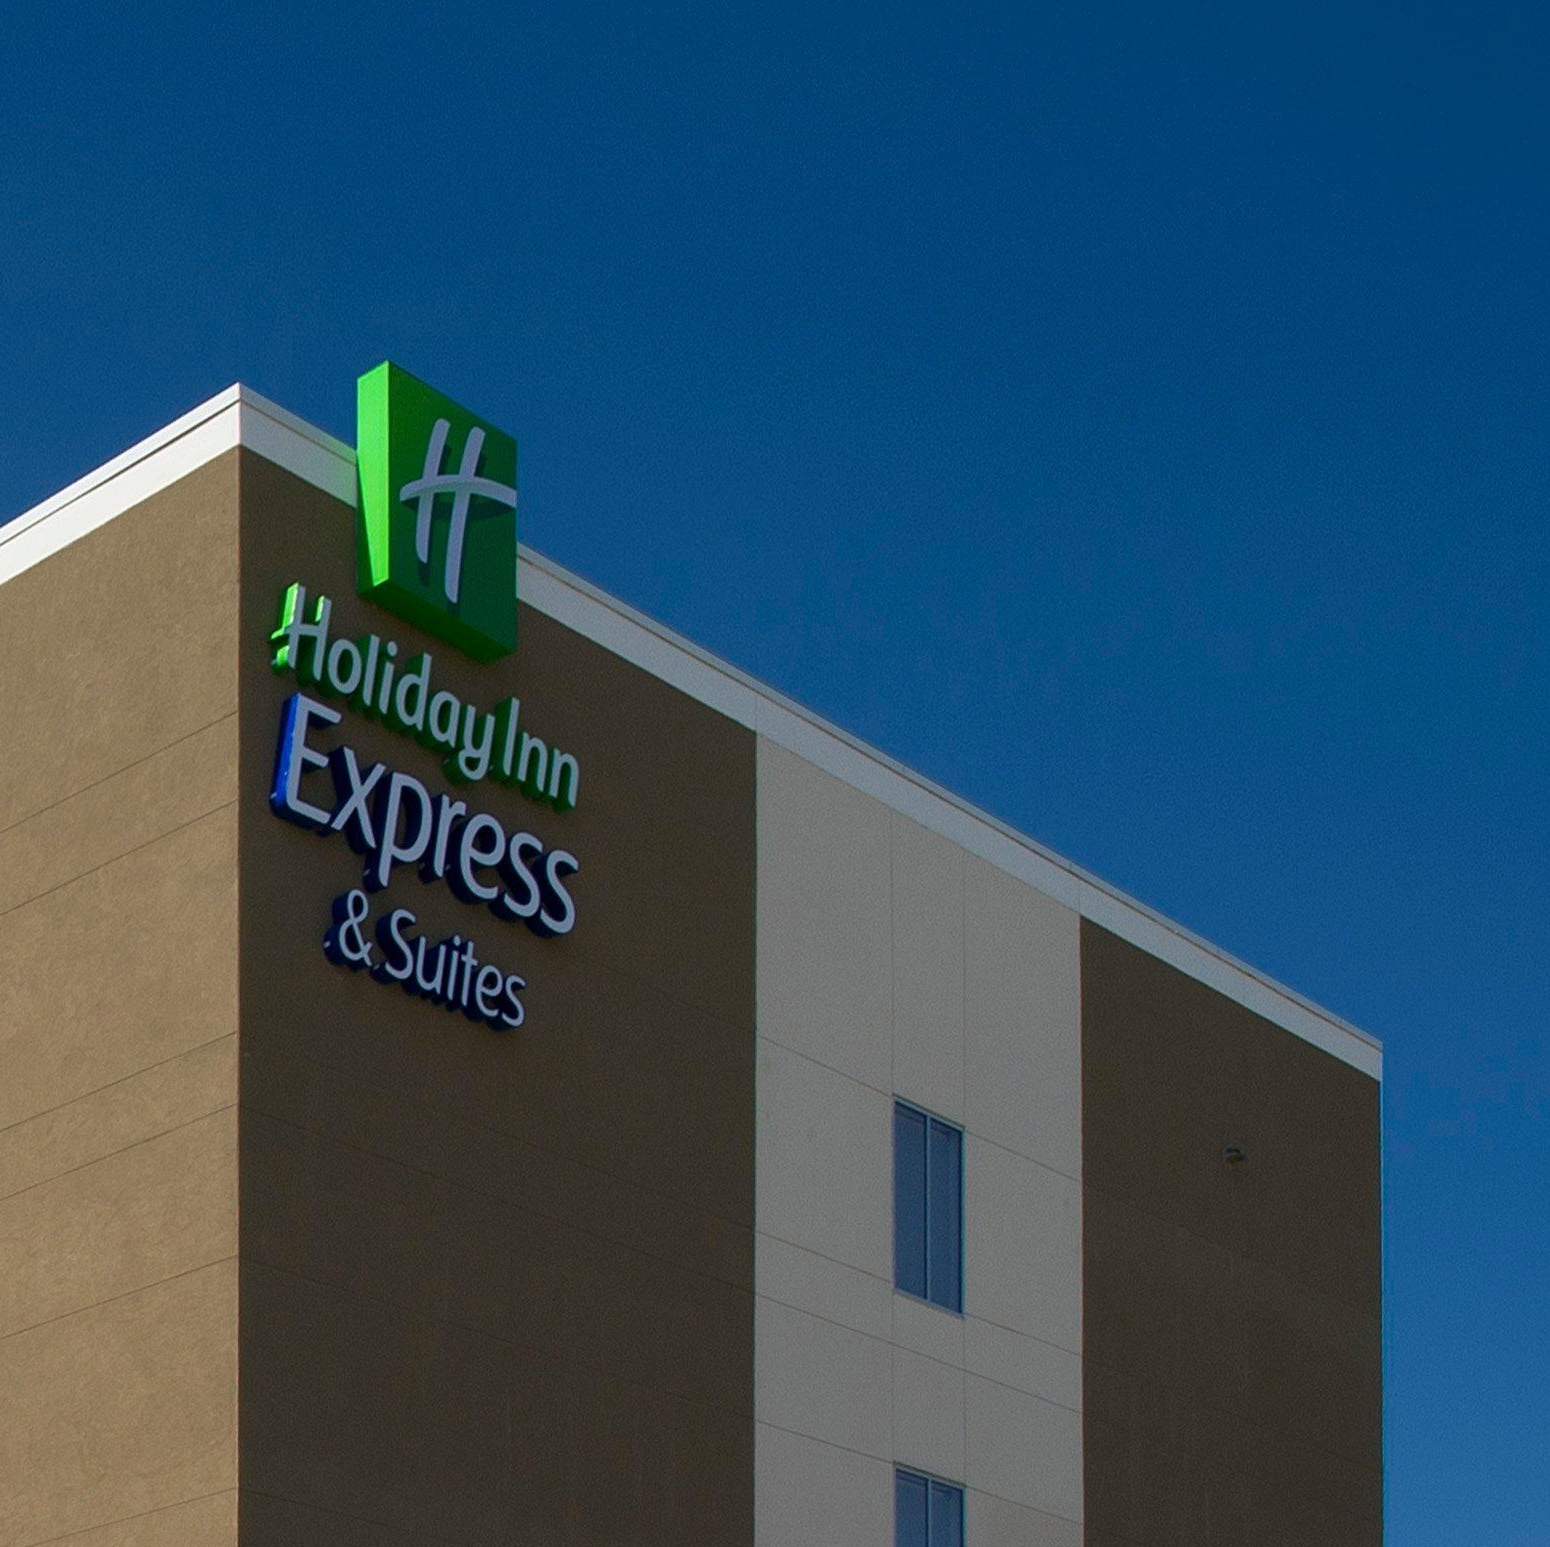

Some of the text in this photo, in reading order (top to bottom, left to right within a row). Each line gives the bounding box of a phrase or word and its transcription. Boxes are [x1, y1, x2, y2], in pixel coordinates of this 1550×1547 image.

[275, 583, 580, 812] Holiday Inn
[272, 692, 580, 938] Express
[332, 889, 527, 1030] & Suites
